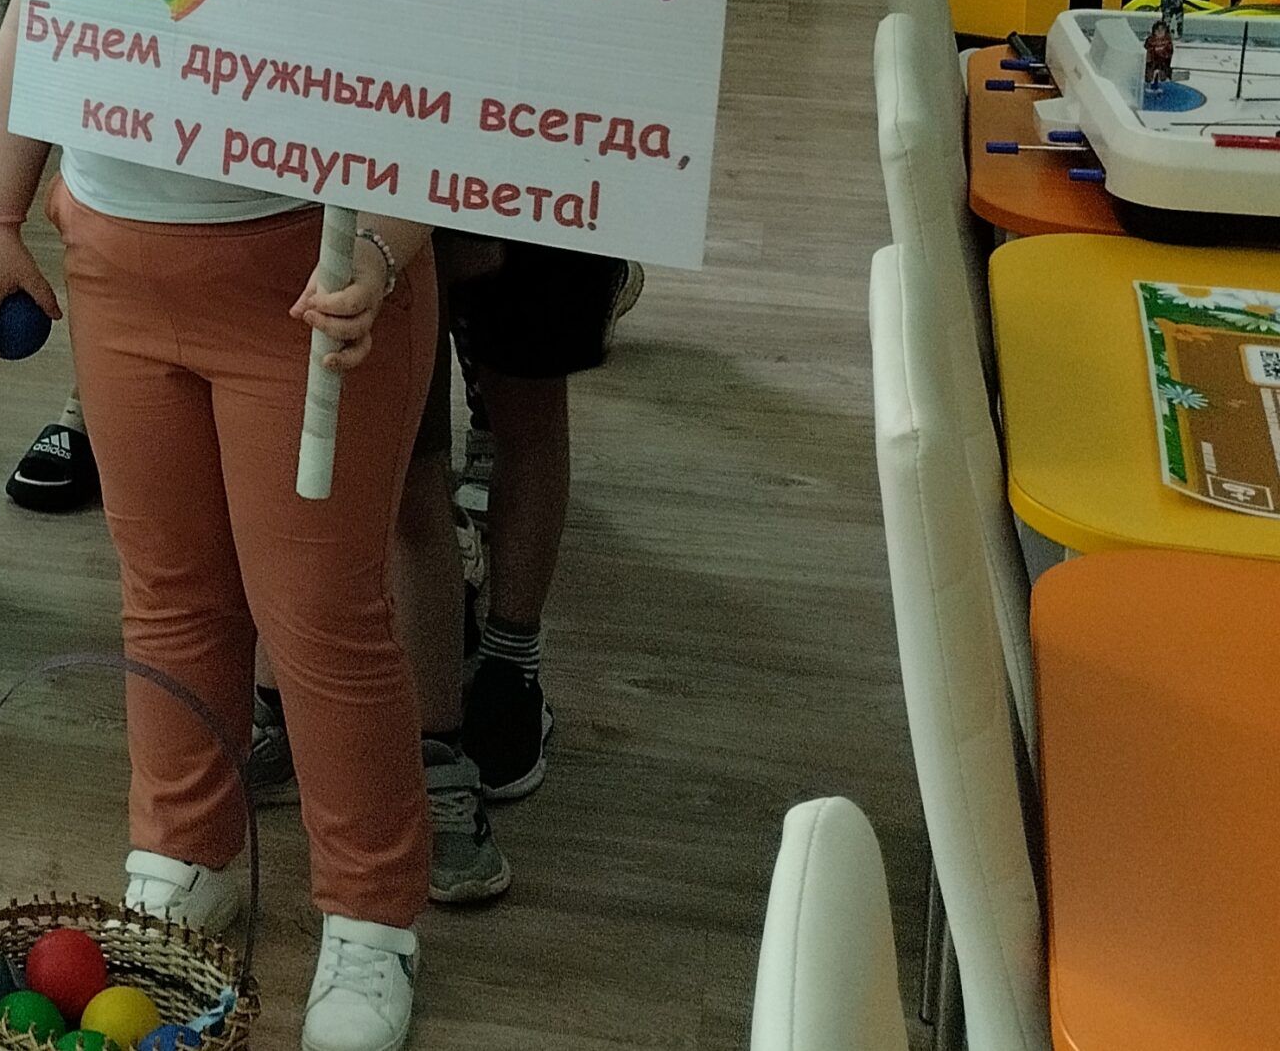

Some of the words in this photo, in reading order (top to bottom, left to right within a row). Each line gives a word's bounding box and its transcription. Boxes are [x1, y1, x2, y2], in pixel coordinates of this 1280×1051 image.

[81, 97, 154, 143] как
[174, 118, 202, 166] у
[222, 127, 400, 195] радуги
[427, 168, 602, 232] цвета!
[180, 41, 452, 124] дружными
[478, 97, 693, 171] всегда,
[32, 442, 73, 460] adidas
